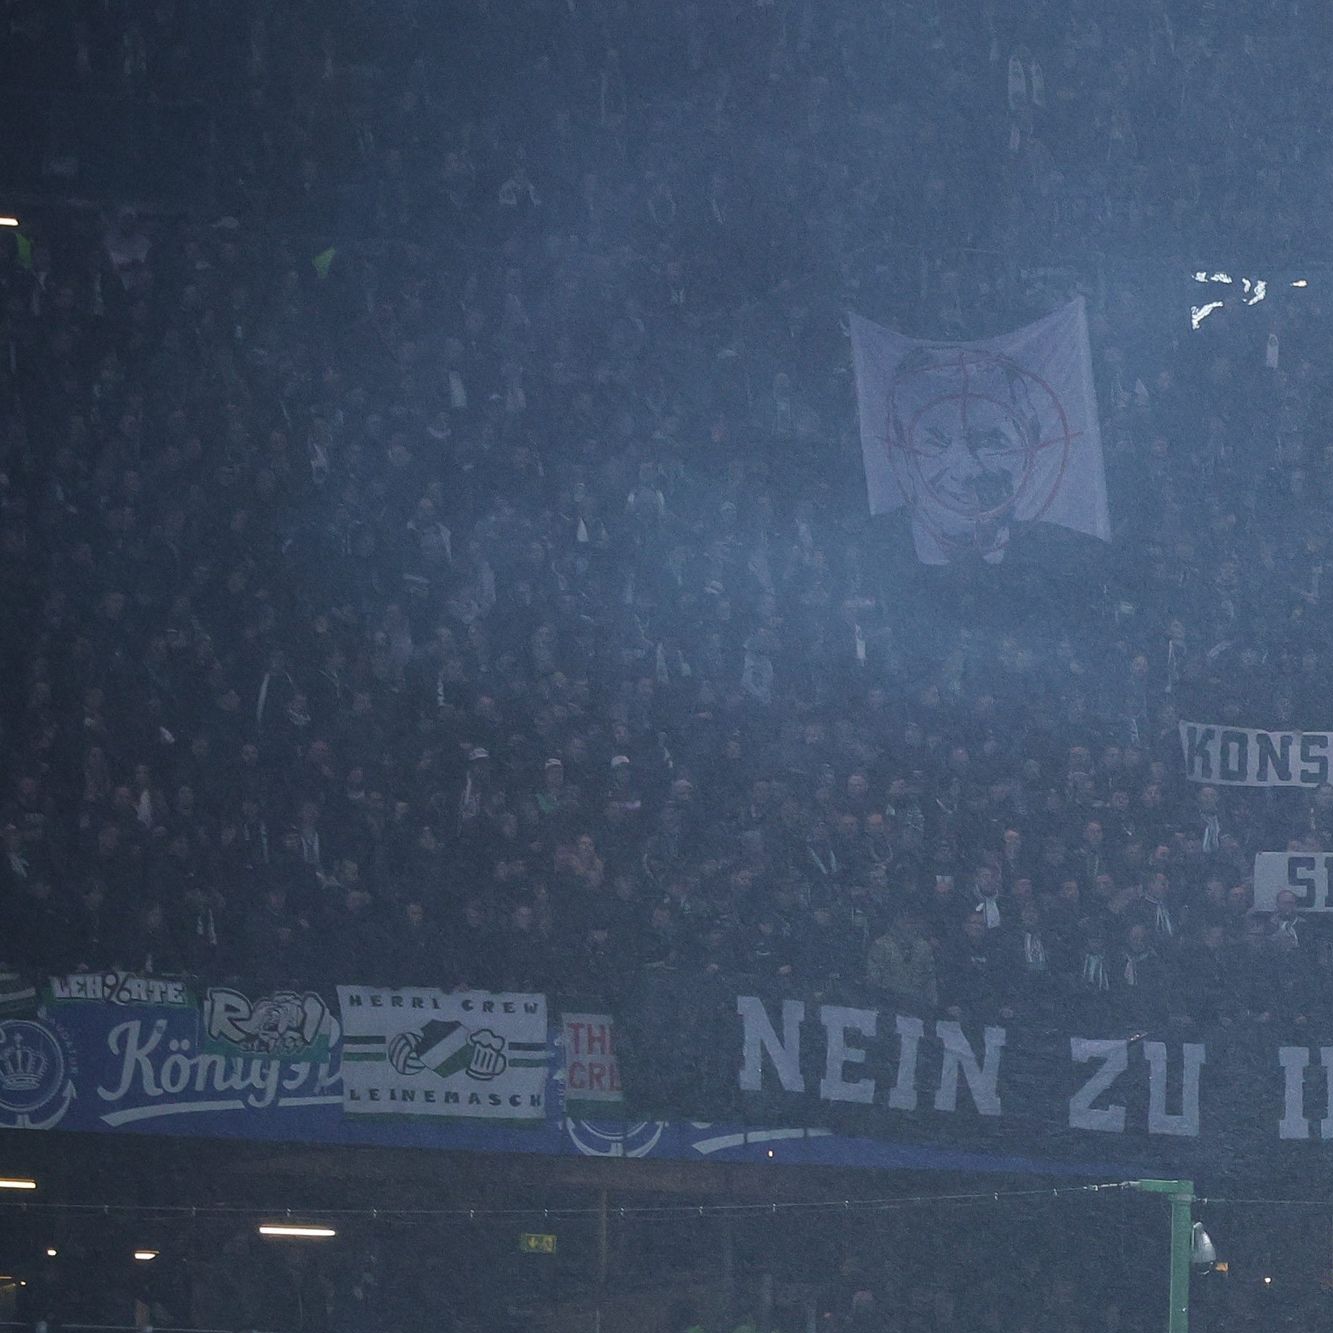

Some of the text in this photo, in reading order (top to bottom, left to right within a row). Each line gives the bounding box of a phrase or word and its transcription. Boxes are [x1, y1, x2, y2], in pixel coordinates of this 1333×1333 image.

[461, 998, 538, 1015] CREW
[738, 996, 1006, 1116] NEIN
[1068, 1038, 1205, 1138] ZU
[349, 1089, 541, 1107] LEINEMASCH
